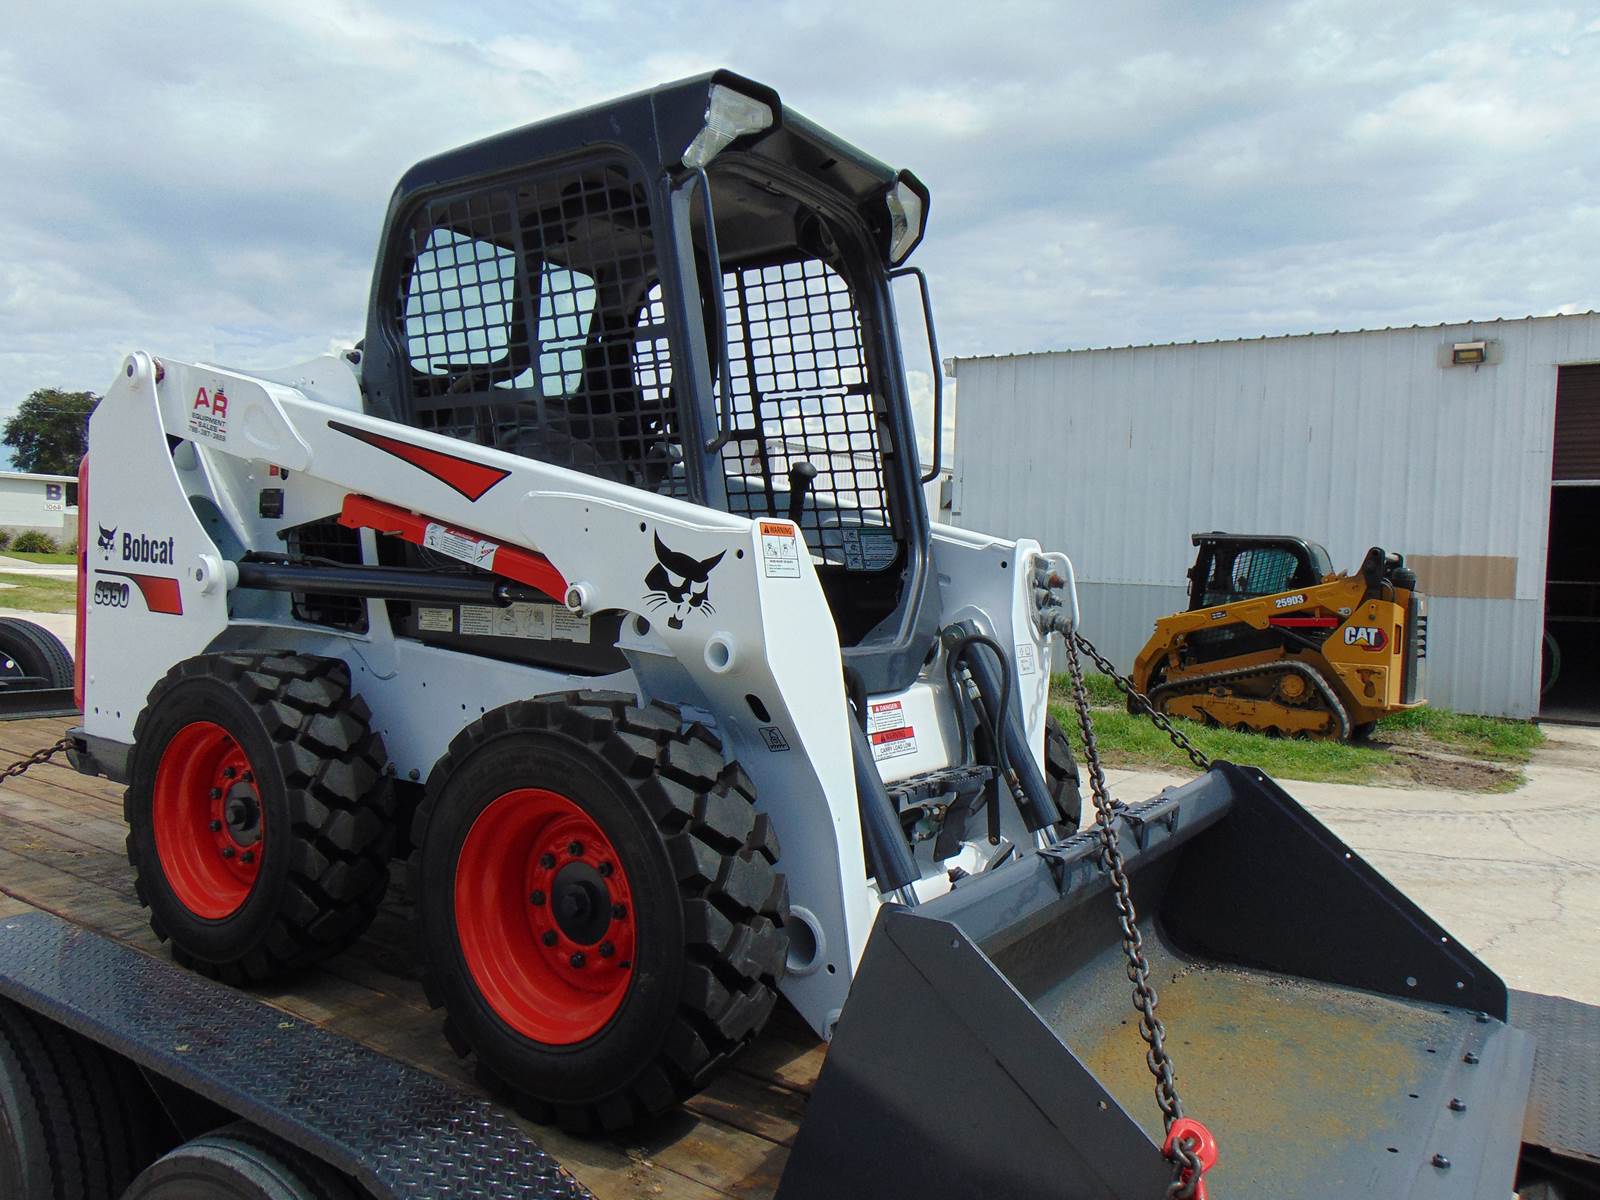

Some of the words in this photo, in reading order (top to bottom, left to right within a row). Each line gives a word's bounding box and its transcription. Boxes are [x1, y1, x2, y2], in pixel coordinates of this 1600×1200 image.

[192, 412, 226, 427] EQUIPMENT
[198, 421, 218, 433] SALES
[46, 483, 62, 501] B
[770, 525, 793, 535] WARNING
[122, 532, 174, 565] Bobcat
[94, 580, 130, 608] S550
[1344, 626, 1379, 646] CAT
[879, 703, 898, 711] DANGER
[885, 730, 906, 741] WARNING
